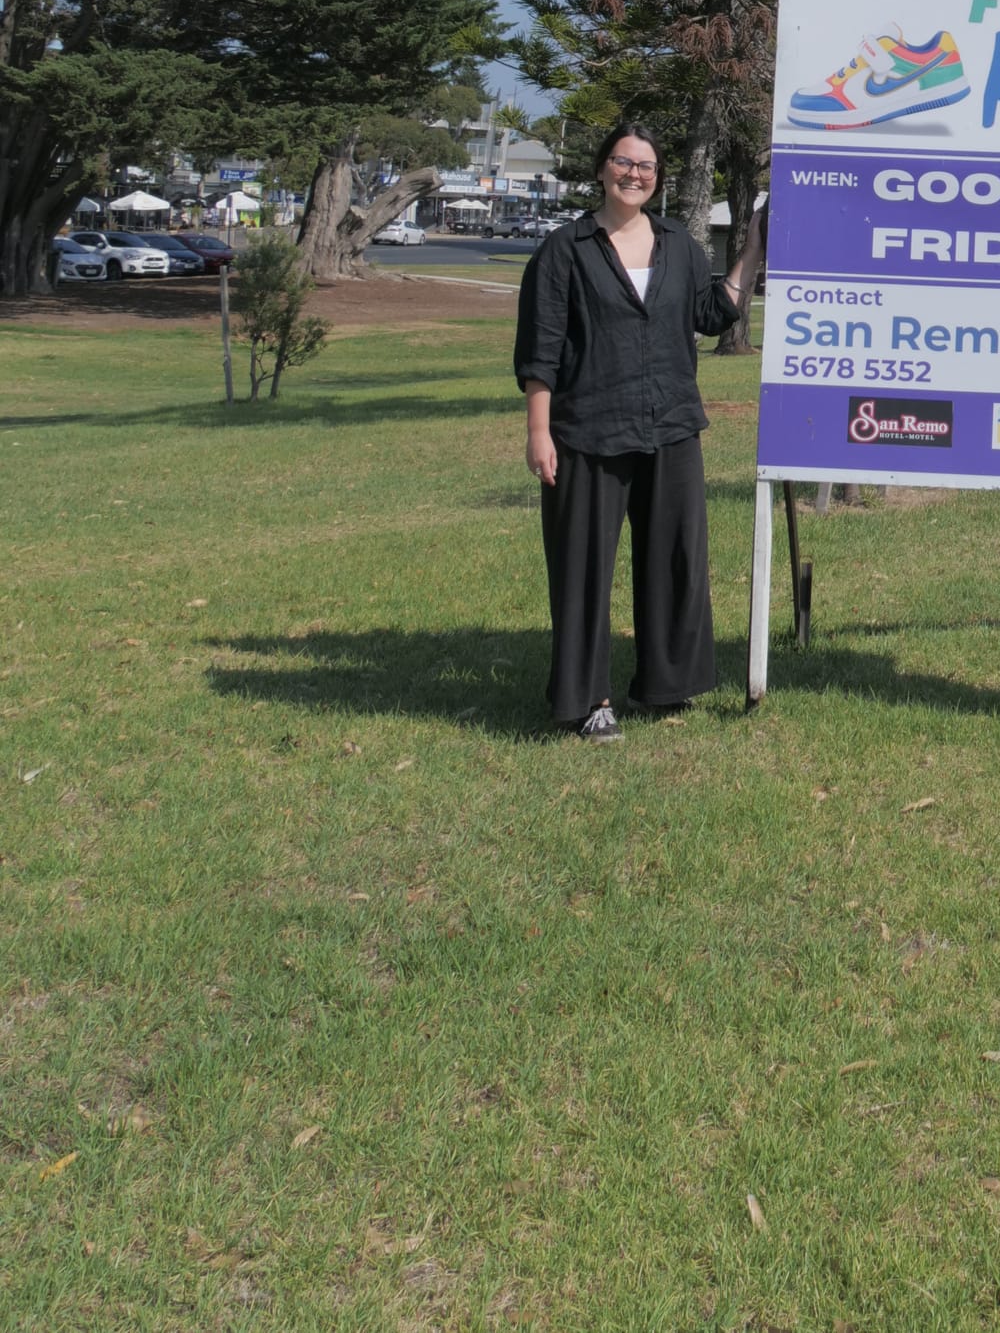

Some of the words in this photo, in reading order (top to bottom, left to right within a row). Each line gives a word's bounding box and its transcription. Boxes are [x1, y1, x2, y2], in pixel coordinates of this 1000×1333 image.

[791, 170, 859, 188] WHEN:
[786, 285, 883, 307] Contact
[784, 311, 873, 349] San
[783, 356, 855, 379] 5678
[864, 358, 932, 383] 5352
[850, 401, 899, 442] San
[901, 415, 949, 434] Remo
